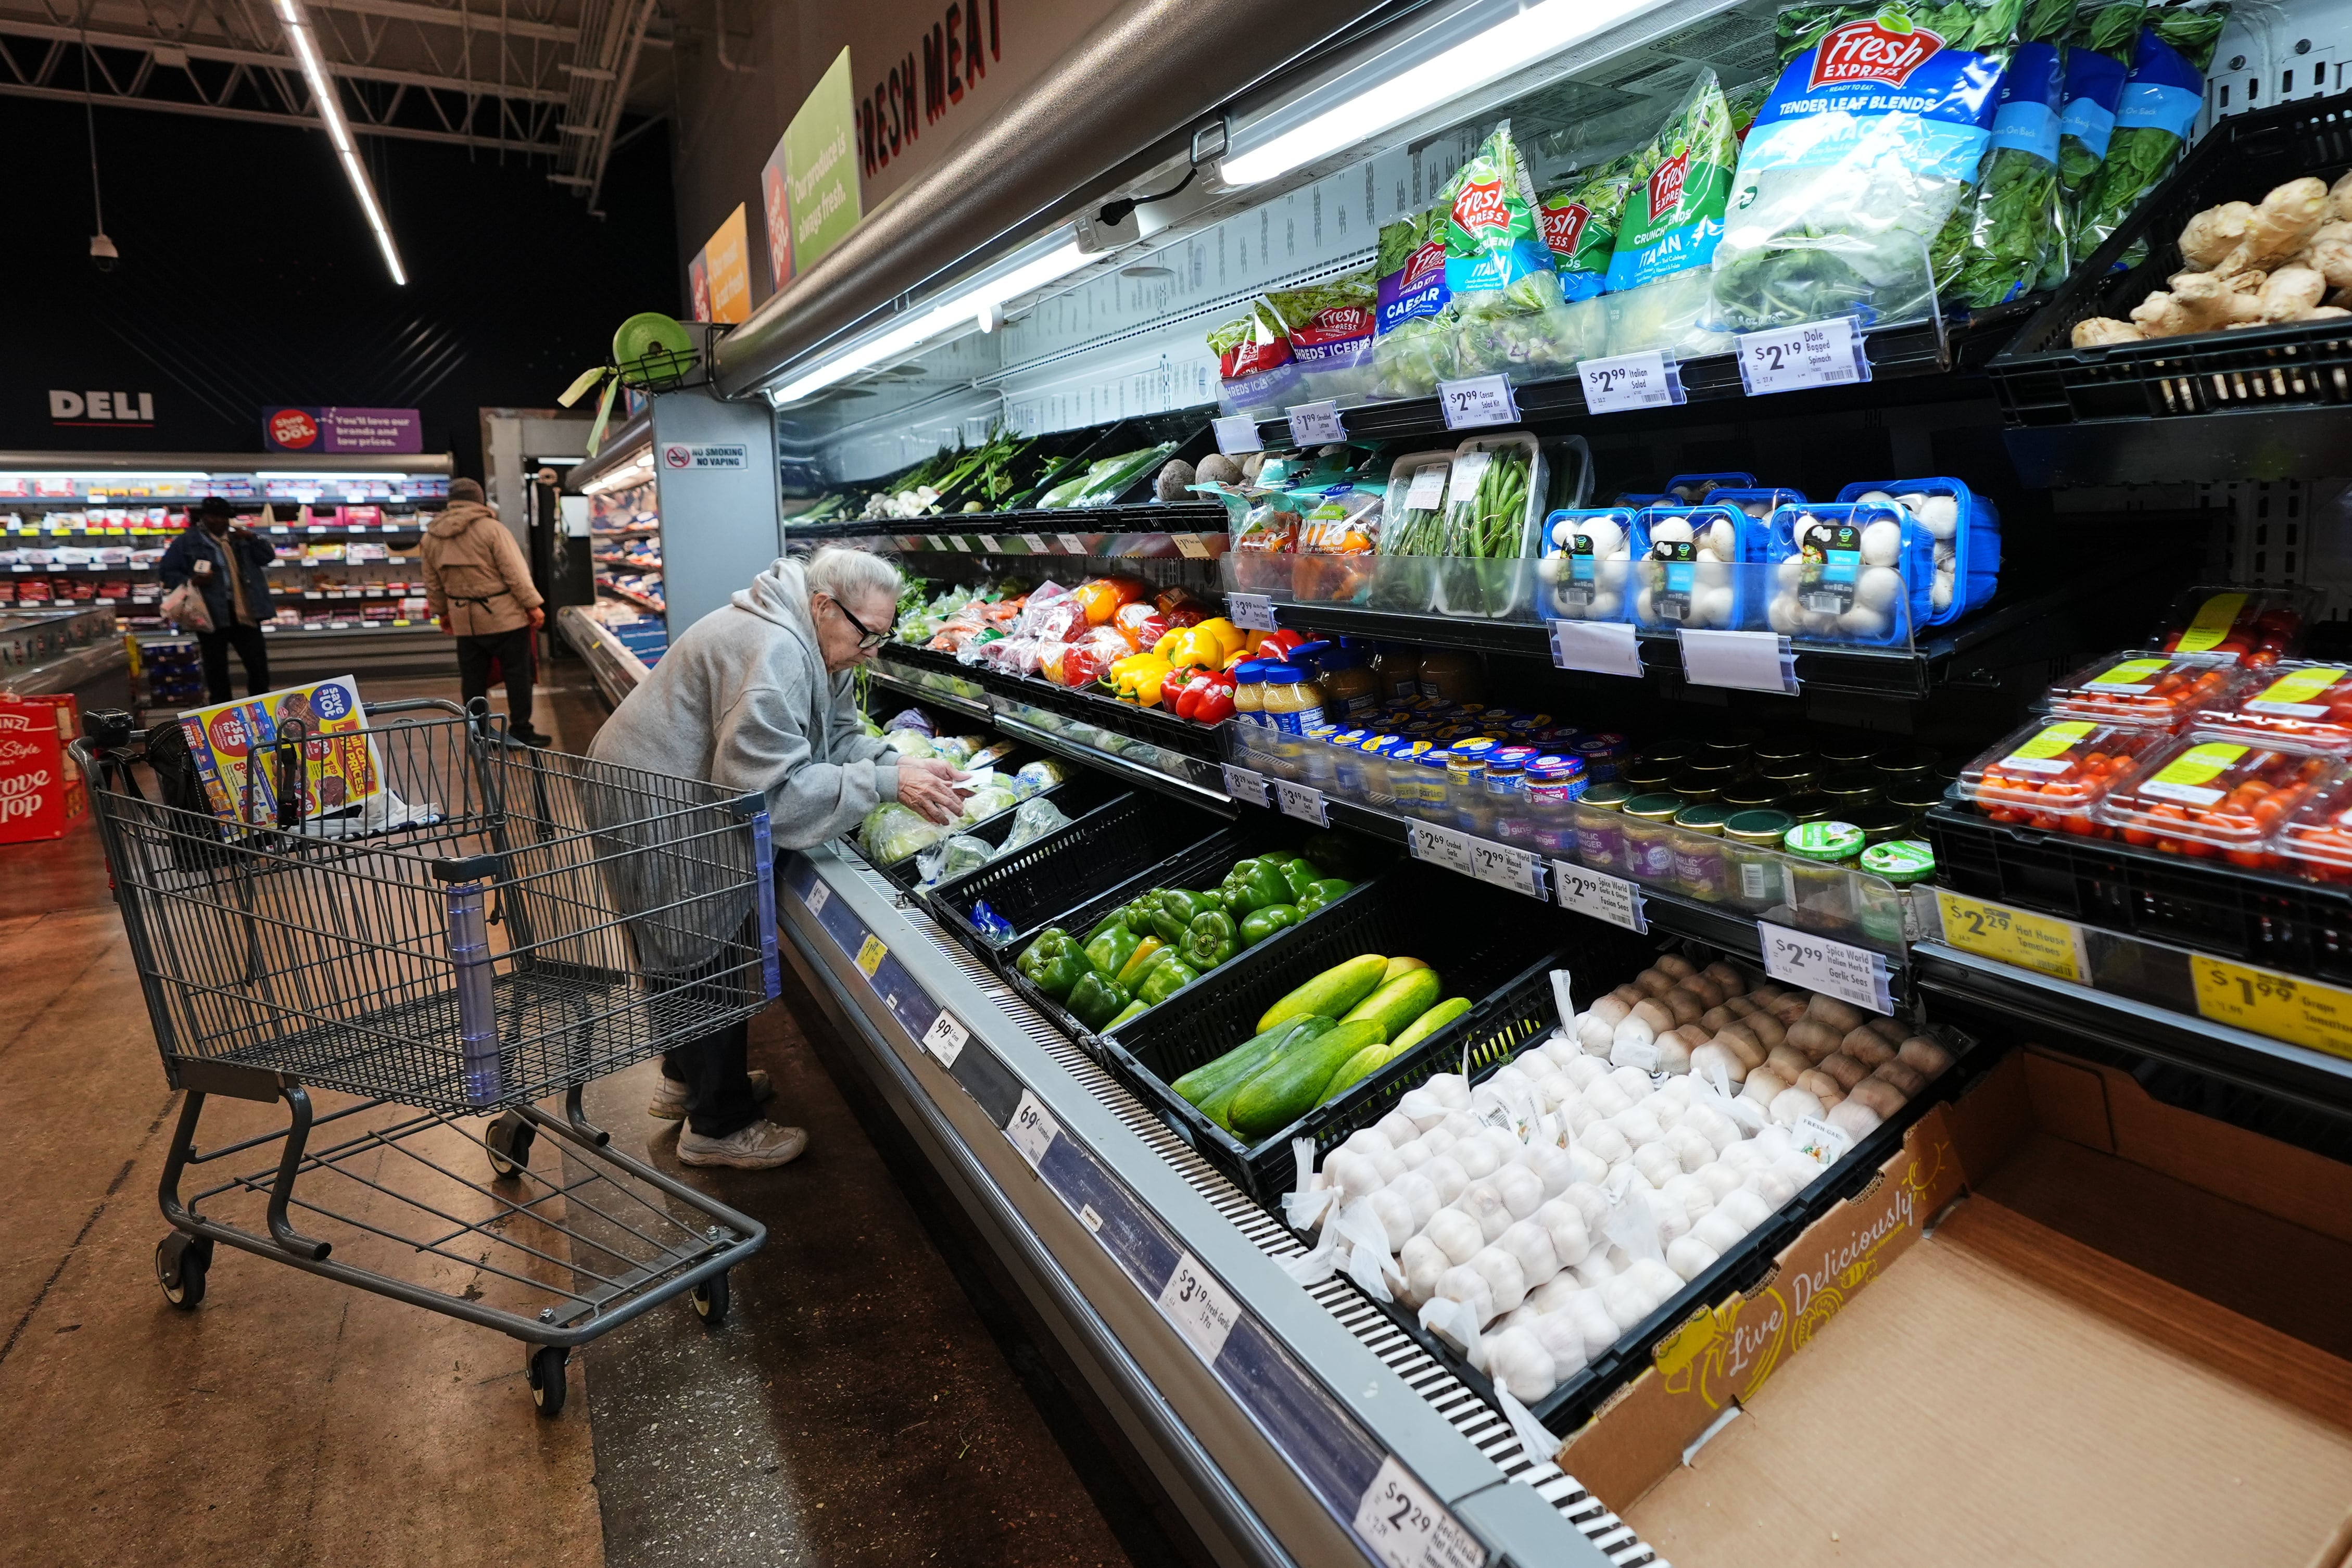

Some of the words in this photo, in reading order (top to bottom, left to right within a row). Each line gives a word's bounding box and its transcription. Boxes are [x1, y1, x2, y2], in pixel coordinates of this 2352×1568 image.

[1649, 29, 1698, 51] CAUTION!
[1826, 27, 1923, 68] Fresh
[1736, 52, 1775, 68] CUIDAD
[1780, 97, 1828, 116] TENDER
[1828, 96, 1868, 112] LEAF
[1868, 95, 1938, 111] BLENDS
[2006, 125, 2018, 134] On
[2020, 127, 2036, 137] Back
[794, 175, 807, 205] Our
[807, 141, 838, 196] produce
[837, 125, 846, 157] is
[1655, 188, 1679, 212] EXPRE
[799, 205, 823, 244] always
[821, 179, 846, 220] fresh.
[1667, 208, 1691, 227] ENDS
[1411, 246, 1446, 274] Fre
[1399, 281, 1424, 297] SALAD
[1424, 274, 1437, 286] KIT
[1386, 287, 1440, 319] CAESAR
[1319, 308, 1360, 328] Fresh
[1804, 328, 1824, 342] Dole
[1329, 338, 1373, 356] ICEBER
[1806, 340, 1831, 353] Bagged
[1809, 354, 1832, 365] Spinach
[1629, 368, 1648, 378] Italian
[1632, 379, 1647, 389] Salad
[49, 389, 155, 420] DELI
[1482, 400, 1493, 409] Salad
[336, 416, 366, 426] You'll
[367, 416, 390, 426] love
[391, 418, 410, 426] our
[1317, 412, 1331, 421] Shredded
[336, 427, 375, 436] brands
[376, 427, 399, 436] and
[337, 437, 357, 446] low
[358, 436, 396, 448] prices.
[705, 448, 743, 457] SMOKING
[329, 687, 345, 715] save
[182, 725, 197, 748] FREE
[222, 722, 231, 734] for
[0, 769, 52, 795] ove
[1447, 773, 1462, 782] arlic
[1303, 795, 1313, 804] Minced
[1419, 787, 1442, 798] garlic
[1534, 791, 1565, 803] ginger
[0, 794, 42, 824] Top
[1446, 839, 1462, 851] Crushed
[1447, 849, 1458, 857] Garlic
[1506, 857, 1522, 868] Minced
[1516, 851, 1530, 862] World
[1507, 866, 1519, 876] Ginger
[1598, 877, 1611, 888] Spice
[1612, 880, 1628, 893] World
[1601, 896, 1616, 907] Fusion
[1617, 902, 1629, 912] Seas
[1615, 891, 1628, 901] Ginger
[2016, 925, 2032, 937] Hot
[2036, 930, 2066, 945] House
[1826, 944, 1845, 957] Spice
[1846, 949, 1869, 964] World
[2017, 937, 2060, 957] Tomatoes
[1827, 955, 1847, 967] Italian
[1848, 963, 1864, 972] Herb
[1829, 968, 1849, 981] Garlic
[1851, 974, 1868, 987] Seas
[1803, 1118, 1825, 1132] FRESH
[1827, 1129, 1843, 1141] GAR
[1729, 1309, 1785, 1377] Live
[1792, 1190, 1914, 1317] Deliciously
[1200, 1311, 1205, 1321] 5
[1204, 1317, 1212, 1329] Pcs
[1205, 1299, 1218, 1318] Fresh
[1217, 1313, 1230, 1332] Garlic
[1433, 1534, 1445, 1552] Hot
[1437, 1514, 1477, 1564] Beefsteak
